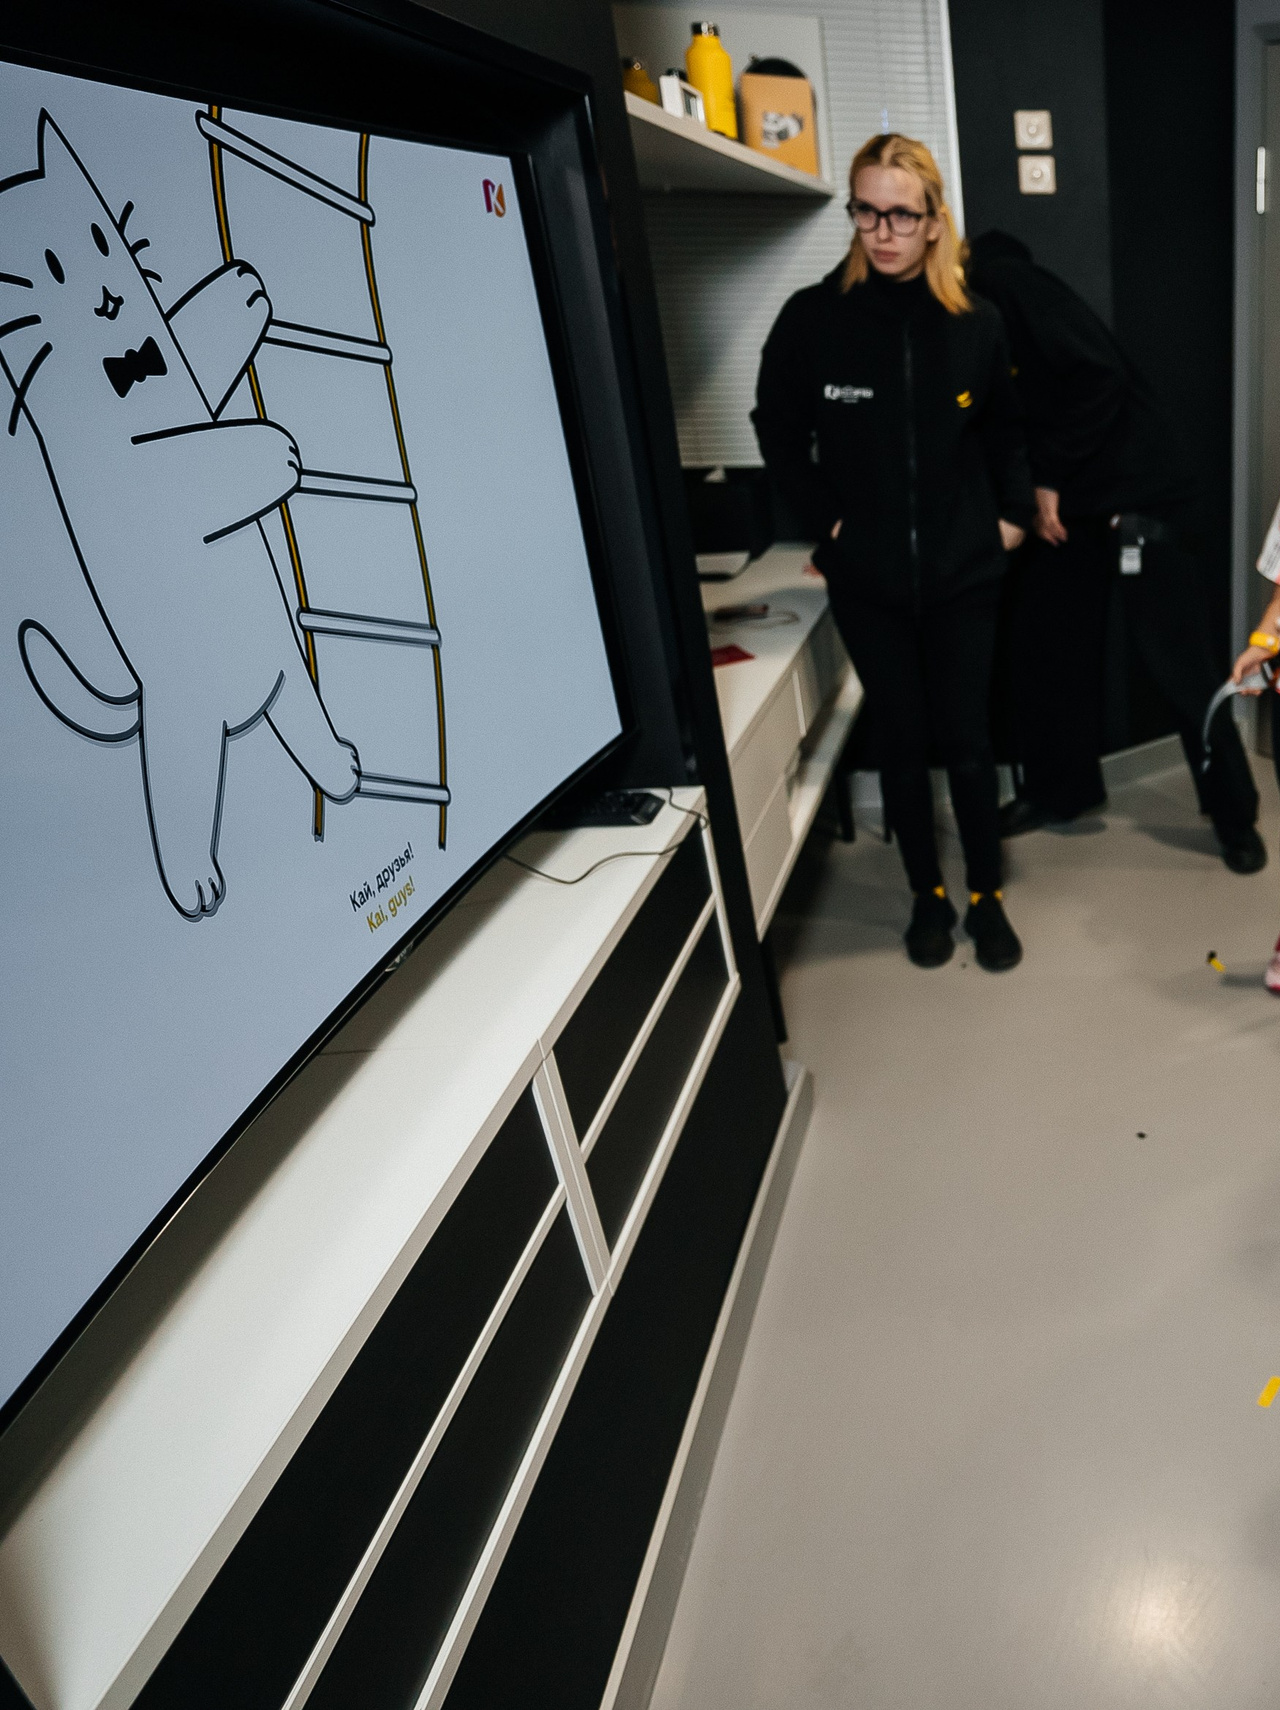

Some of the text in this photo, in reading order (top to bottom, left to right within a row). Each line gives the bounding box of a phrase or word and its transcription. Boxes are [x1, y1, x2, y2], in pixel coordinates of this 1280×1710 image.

[349, 842, 414, 912] Кай, друзья!
[366, 875, 416, 933] Kai, guys!
